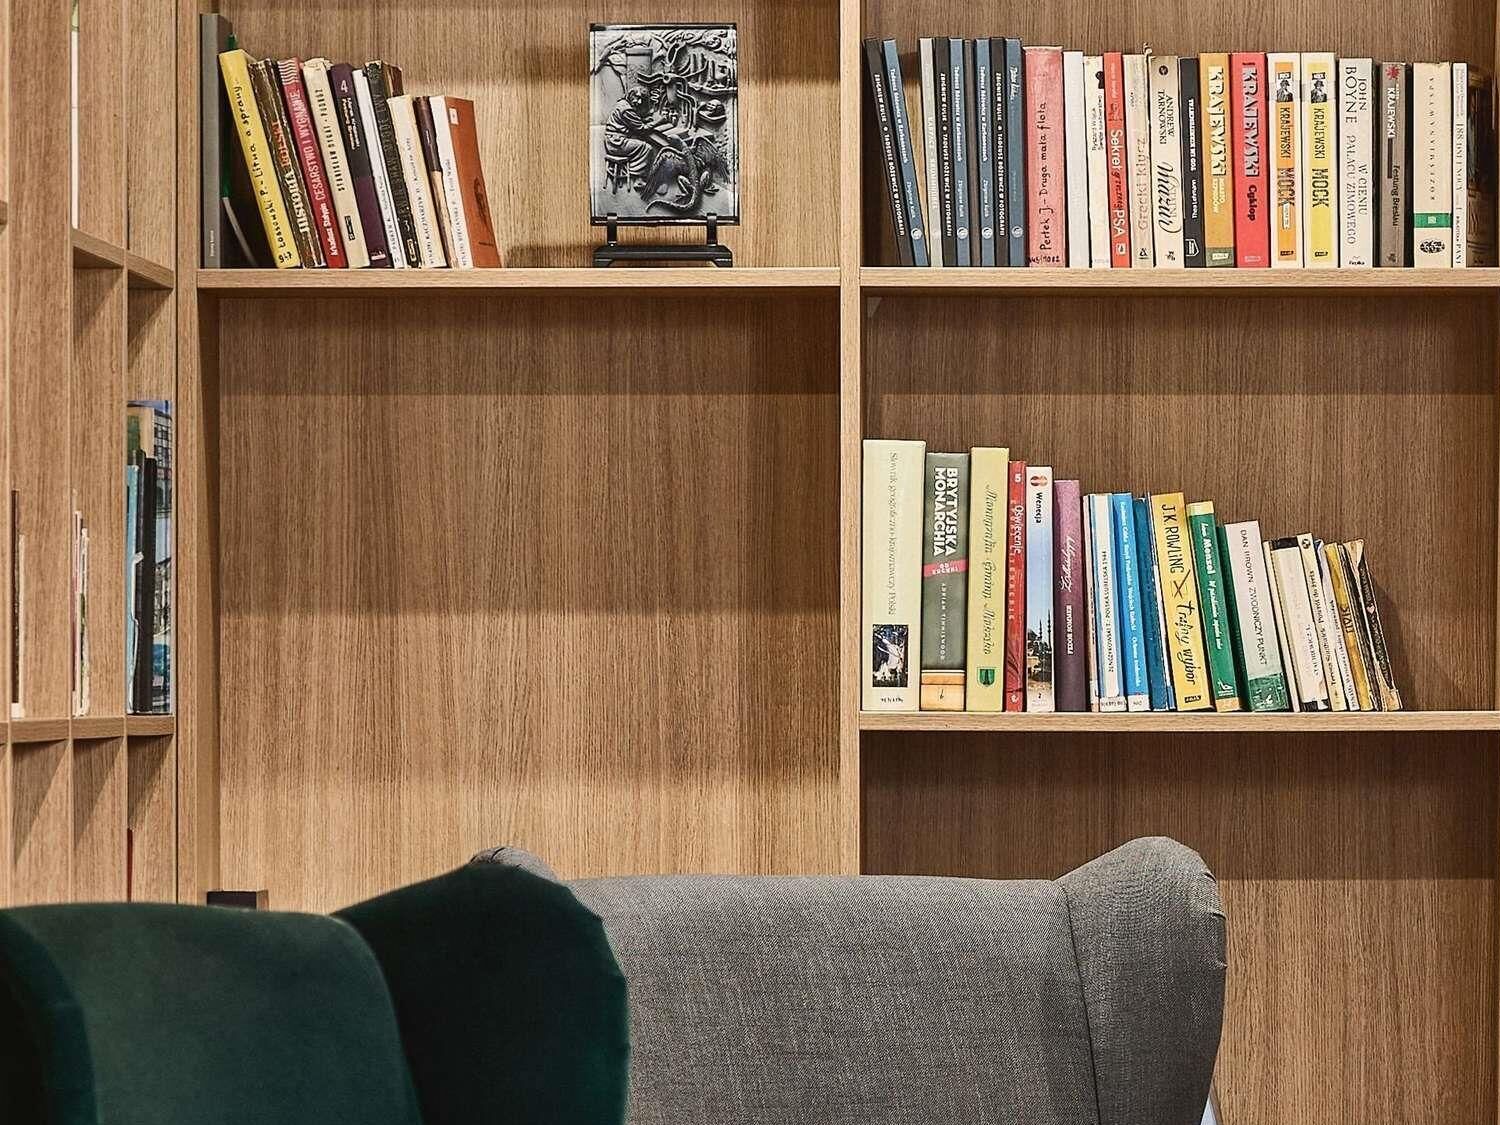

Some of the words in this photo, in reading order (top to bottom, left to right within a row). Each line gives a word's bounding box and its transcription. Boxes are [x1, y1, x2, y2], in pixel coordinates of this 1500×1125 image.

[939, 72, 947, 101] ZBIGNIEW
[994, 72, 1002, 101] ZBIGNIEW
[1342, 65, 1359, 123] BOYNE
[1357, 77, 1367, 111] JOHN
[288, 88, 311, 138] WYGNANIE
[873, 73, 884, 102] ZBIGNIEW
[883, 134, 893, 160] TADEUSZ
[1036, 102, 1050, 130] flota
[1157, 89, 1166, 144] TARNOWSKI
[1165, 94, 1174, 136] ANDREW
[1203, 65, 1230, 176] KRAJEWSKI
[1240, 66, 1262, 175] KRAJEWSKI
[1278, 107, 1292, 159] KRAJEWSKI
[1311, 107, 1326, 159] KRAJEWSKI
[1387, 88, 1396, 137] KRAJEWSKI
[1109, 129, 1124, 170] Sekret
[303, 145, 326, 201] CESARSTWO
[1038, 165, 1050, 195] Druga
[1273, 166, 1301, 207] MOCK
[1309, 167, 1331, 208] MOCK
[1246, 184, 1257, 220] Cyklop
[1346, 182, 1358, 244] ZIMOWEGO
[1358, 178, 1367, 215] CIENIU
[1391, 197, 1400, 226] Breslau
[1038, 218, 1051, 250] Pertek
[1111, 208, 1126, 237] PSA
[932, 467, 945, 556] MONARCHIA
[944, 467, 958, 556] BRYTYJSKA
[1033, 492, 1042, 523] Wenecja
[1240, 529, 1248, 547] DAN
[1248, 587, 1262, 636] ZWODNICZY
[1256, 637, 1267, 665] PUNKT
